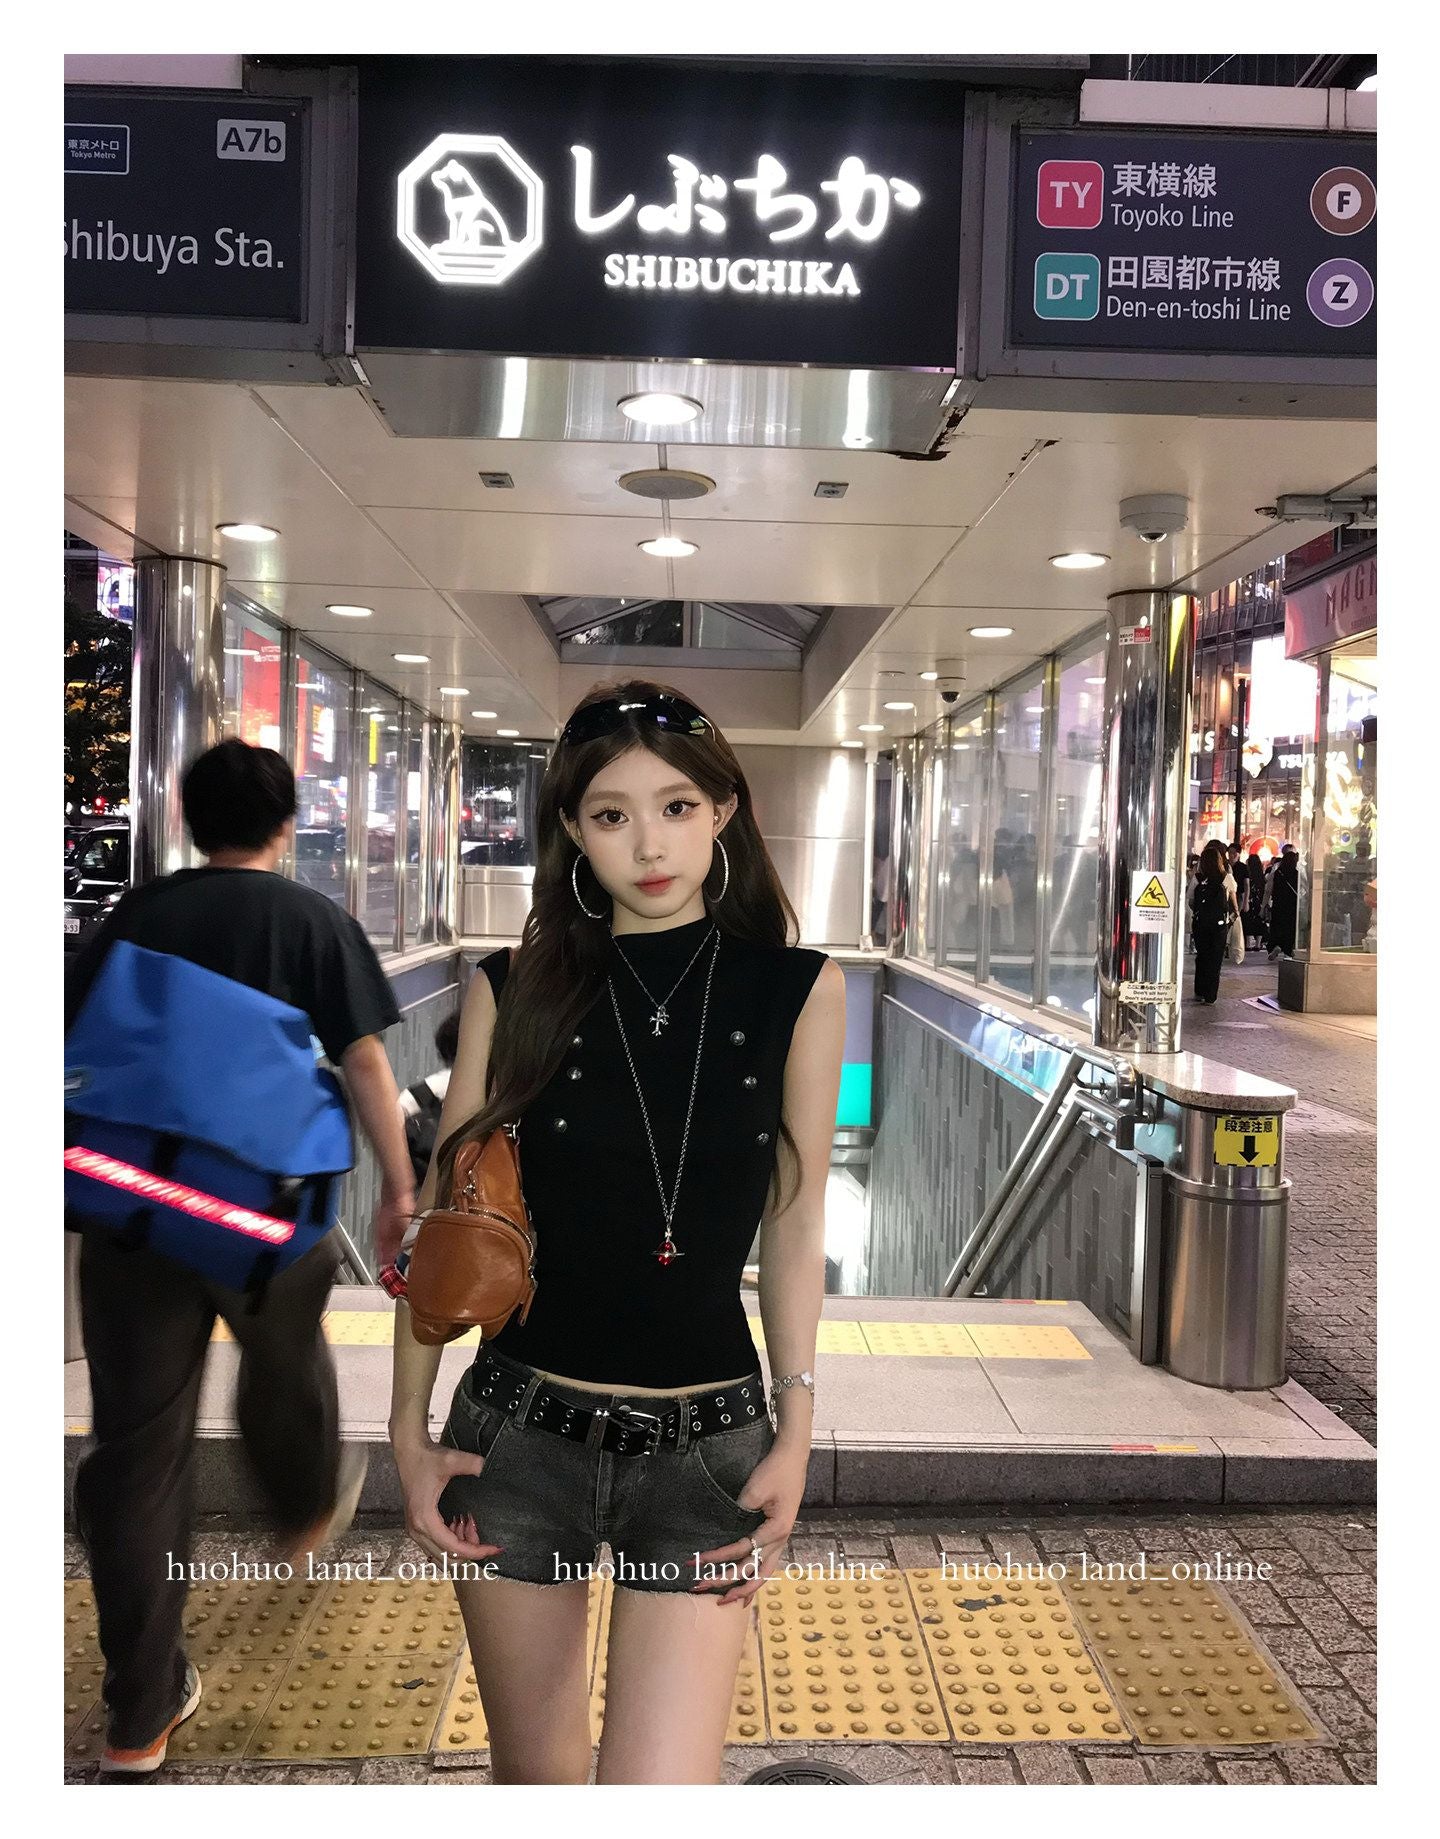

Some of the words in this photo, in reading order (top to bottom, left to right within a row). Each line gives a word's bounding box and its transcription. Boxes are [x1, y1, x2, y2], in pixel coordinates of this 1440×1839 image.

[67, 139, 119, 150] 東京メトロ
[71, 150, 92, 159] Tokyo
[93, 151, 116, 159] Metro
[221, 127, 282, 154] A7b
[569, 144, 922, 242] しぶちか
[1111, 161, 1218, 199] 東横線
[1050, 181, 1093, 209] TY
[1337, 190, 1352, 213] F
[1111, 203, 1184, 232] Toyoko
[1191, 204, 1234, 228] Line
[64, 218, 199, 275] hibuya
[214, 227, 284, 269] Sta.
[603, 252, 862, 297] SHIBUCHIKA
[1046, 273, 1090, 301] DT
[1107, 254, 1282, 292] 田園都市線
[1330, 281, 1350, 304] Z
[1106, 295, 1241, 320] Den-en-toshi
[1249, 298, 1291, 321] Line
[1225, 1119, 1273, 1133] 段差注意
